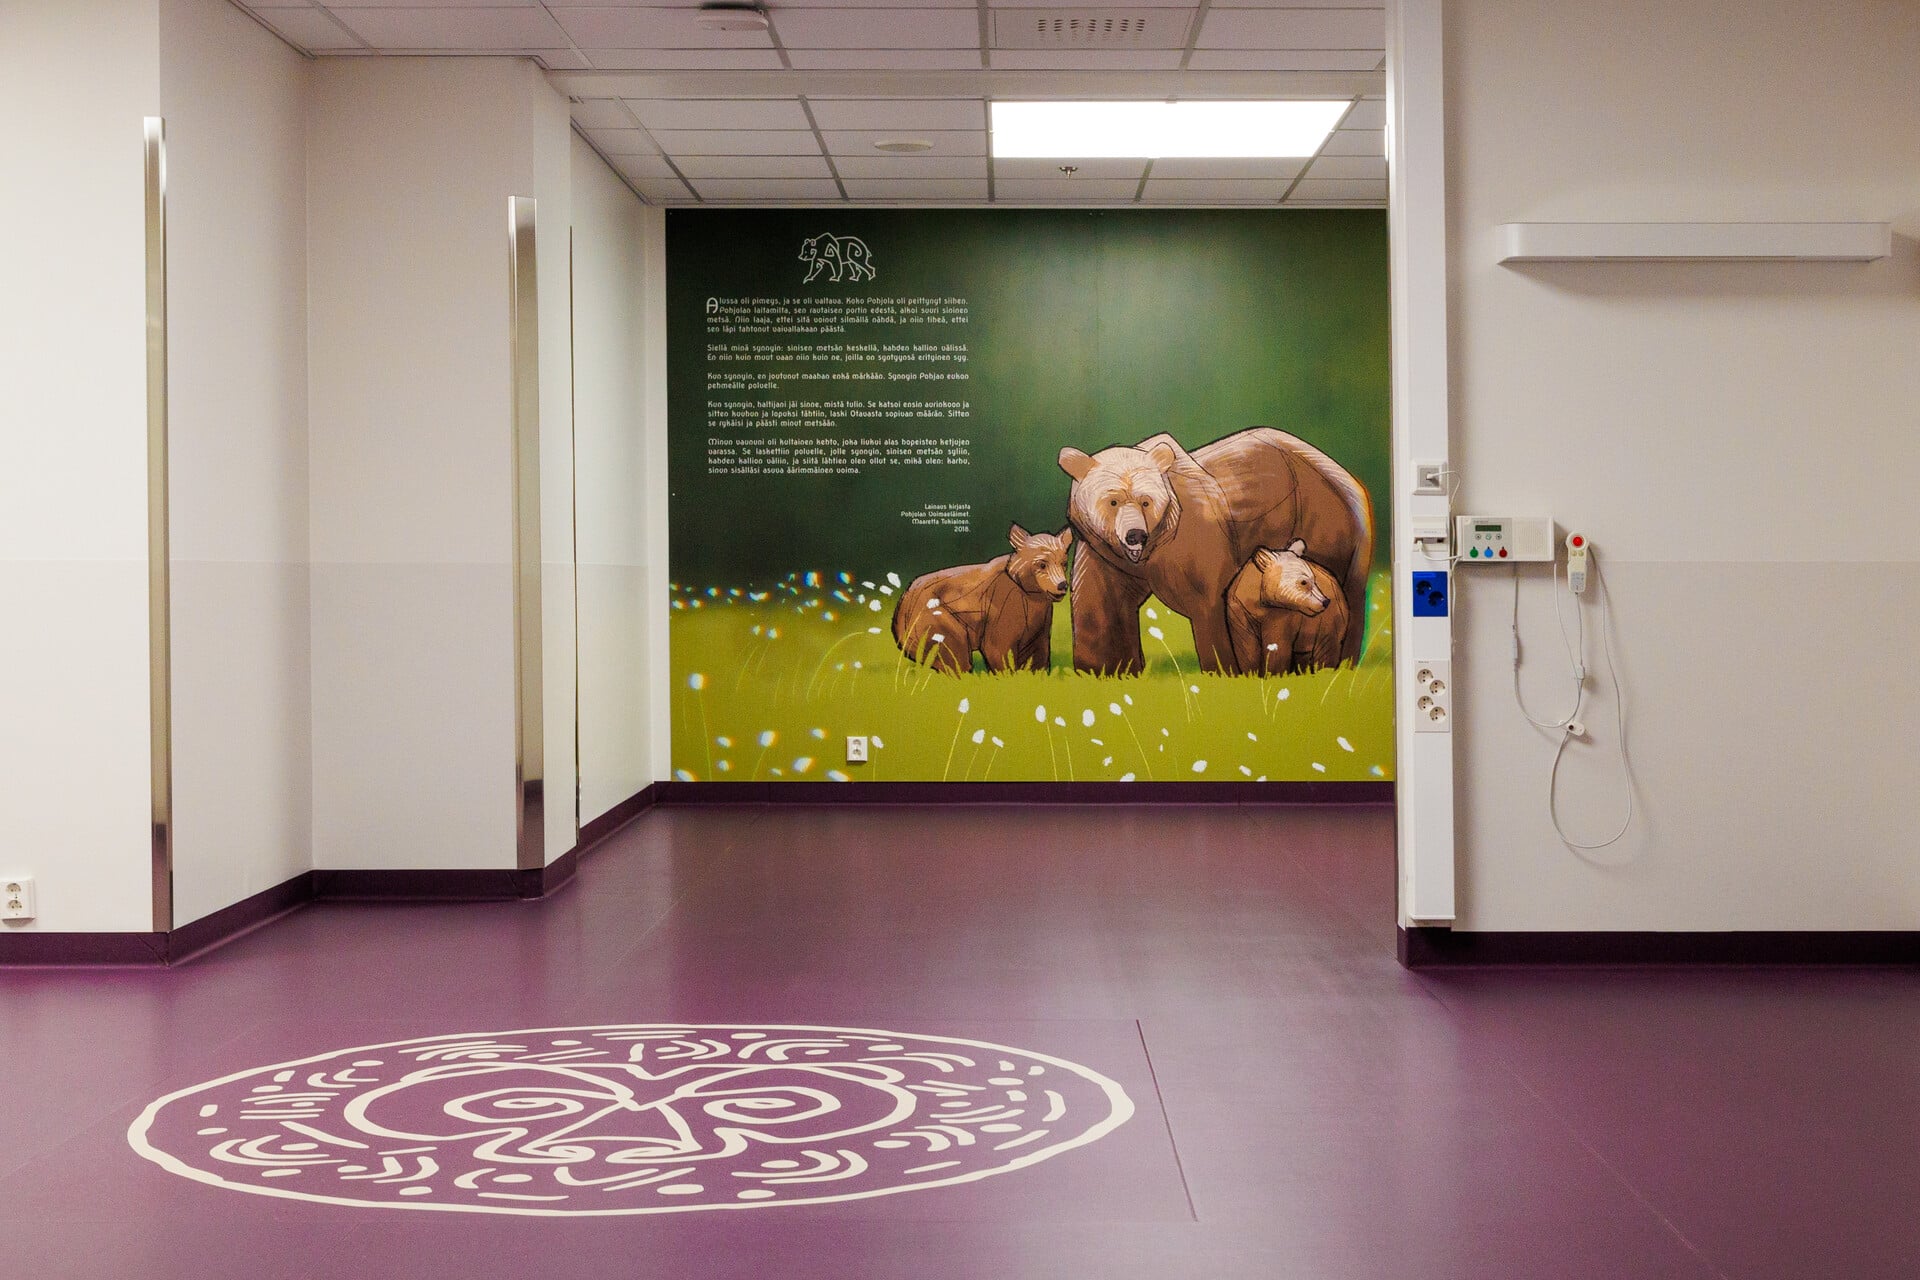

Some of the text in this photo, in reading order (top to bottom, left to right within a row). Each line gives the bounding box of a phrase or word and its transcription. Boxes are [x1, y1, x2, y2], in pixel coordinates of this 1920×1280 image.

[783, 297, 790, 307] ja
[866, 297, 894, 307] Pohjola
[908, 297, 942, 307] peittynyt
[719, 306, 751, 316] Pohjolan
[754, 306, 791, 314] laitamilta,
[846, 306, 868, 316] portin
[753, 315, 773, 325] laaja,
[899, 315, 907, 325] ja
[927, 315, 948, 323] tiheä,
[722, 325, 736, 335] läpi
[846, 344, 880, 352] keskellä,
[845, 353, 864, 363] joilla
[918, 353, 951, 363] erityinen
[724, 372, 755, 382] synnyin,
[768, 372, 800, 382] joutunut
[888, 372, 918, 382] Synnyin
[919, 372, 945, 382] Pohjan
[707, 381, 780, 391] pehmeälle polvelle.
[724, 400, 755, 410] synnyin,
[757, 400, 787, 410] haltijani
[788, 400, 798, 410] jäi
[962, 400, 970, 410] ja
[762, 409, 769, 419] ja
[771, 409, 798, 419] lopuksi
[801, 409, 827, 417] tähtiin,
[885, 409, 914, 419] sopivan
[746, 419, 754, 429] ja
[755, 419, 778, 429] päästi
[816, 438, 840, 446] kehto,
[842, 438, 858, 448] joka
[901, 438, 938, 448] hopeisten
[940, 438, 970, 448] ketjujen
[794, 447, 826, 457] polvelle,
[830, 447, 846, 457] jolle
[850, 447, 882, 457] synnyin,
[948, 447, 970, 457] syliin,
[766, 457, 789, 465] väliin,
[792, 457, 800, 467] ja
[946, 457, 970, 465] karhu,
